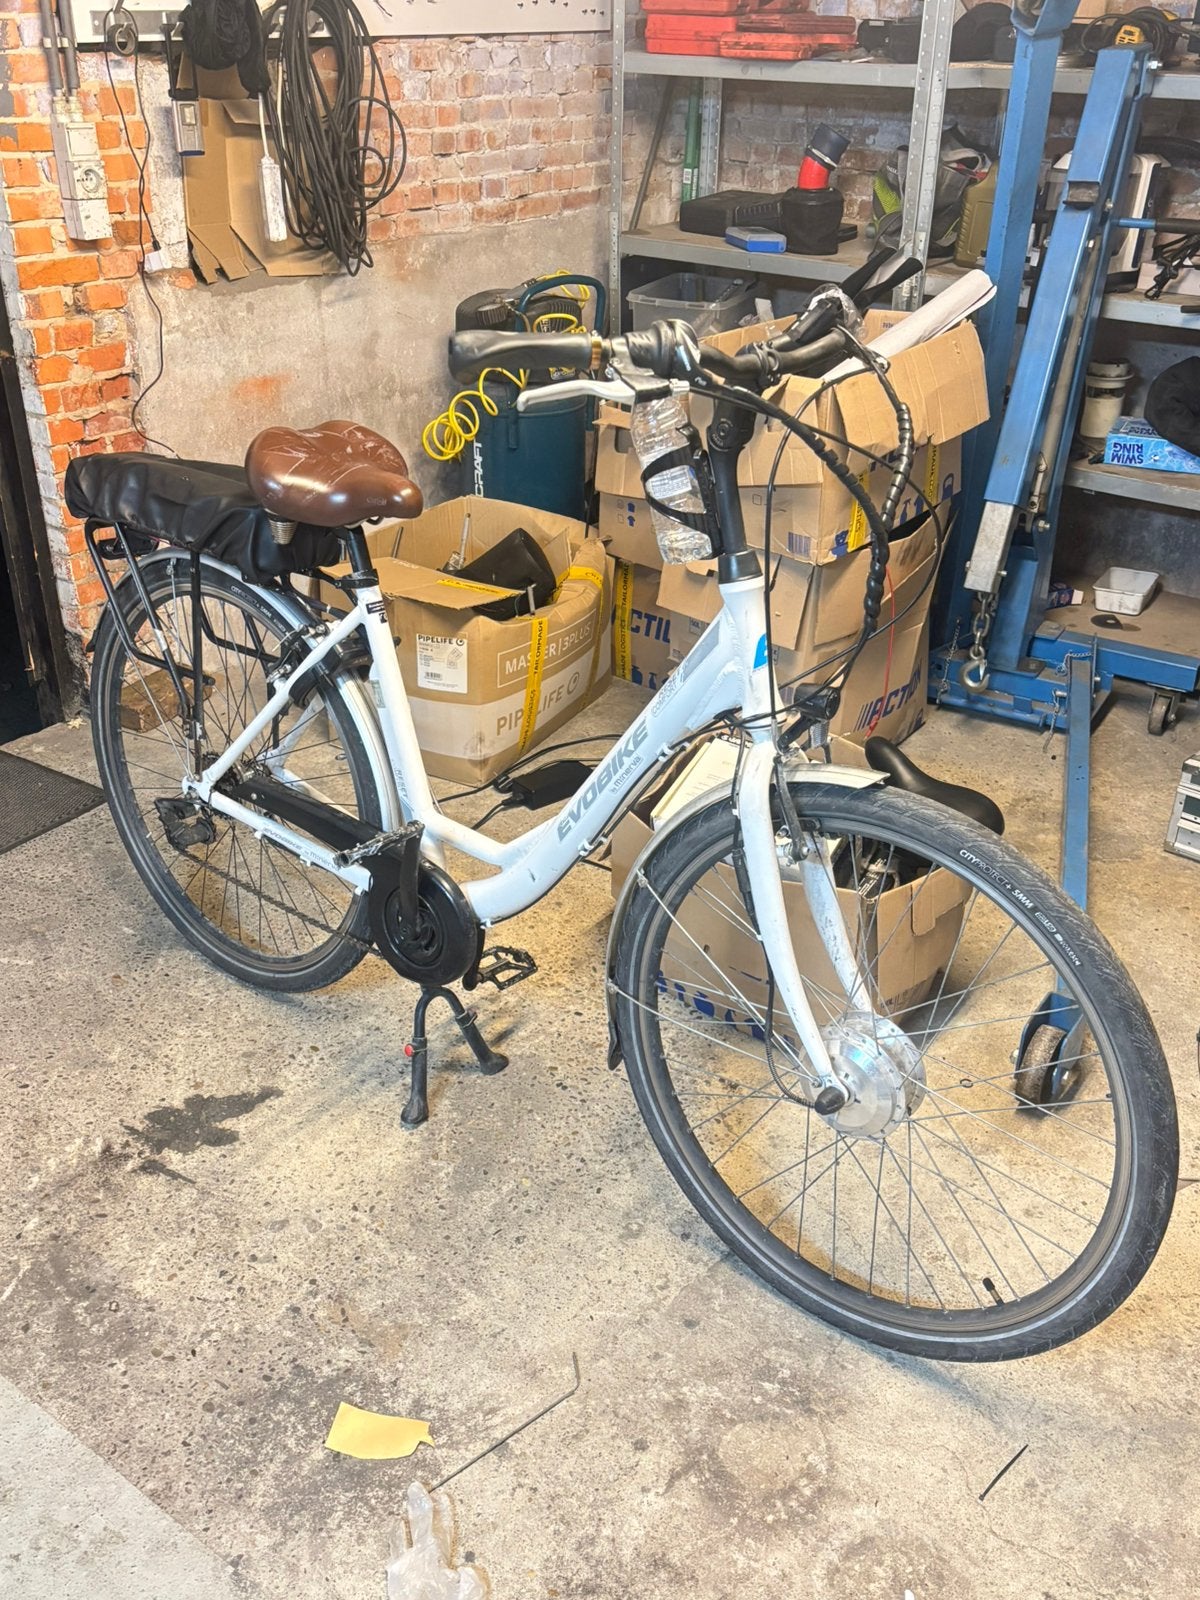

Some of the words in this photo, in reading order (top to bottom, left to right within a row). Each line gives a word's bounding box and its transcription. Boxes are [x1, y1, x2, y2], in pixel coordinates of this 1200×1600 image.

[1111, 452, 1144, 464] SWIM
[1113, 442, 1144, 454] RING
[417, 634, 454, 645] PIPELIFE
[533, 619, 545, 675] TAILORMADE
[556, 719, 649, 842] EVOBIKE
[613, 755, 642, 789] minerva
[1011, 888, 1034, 909] 5MM
